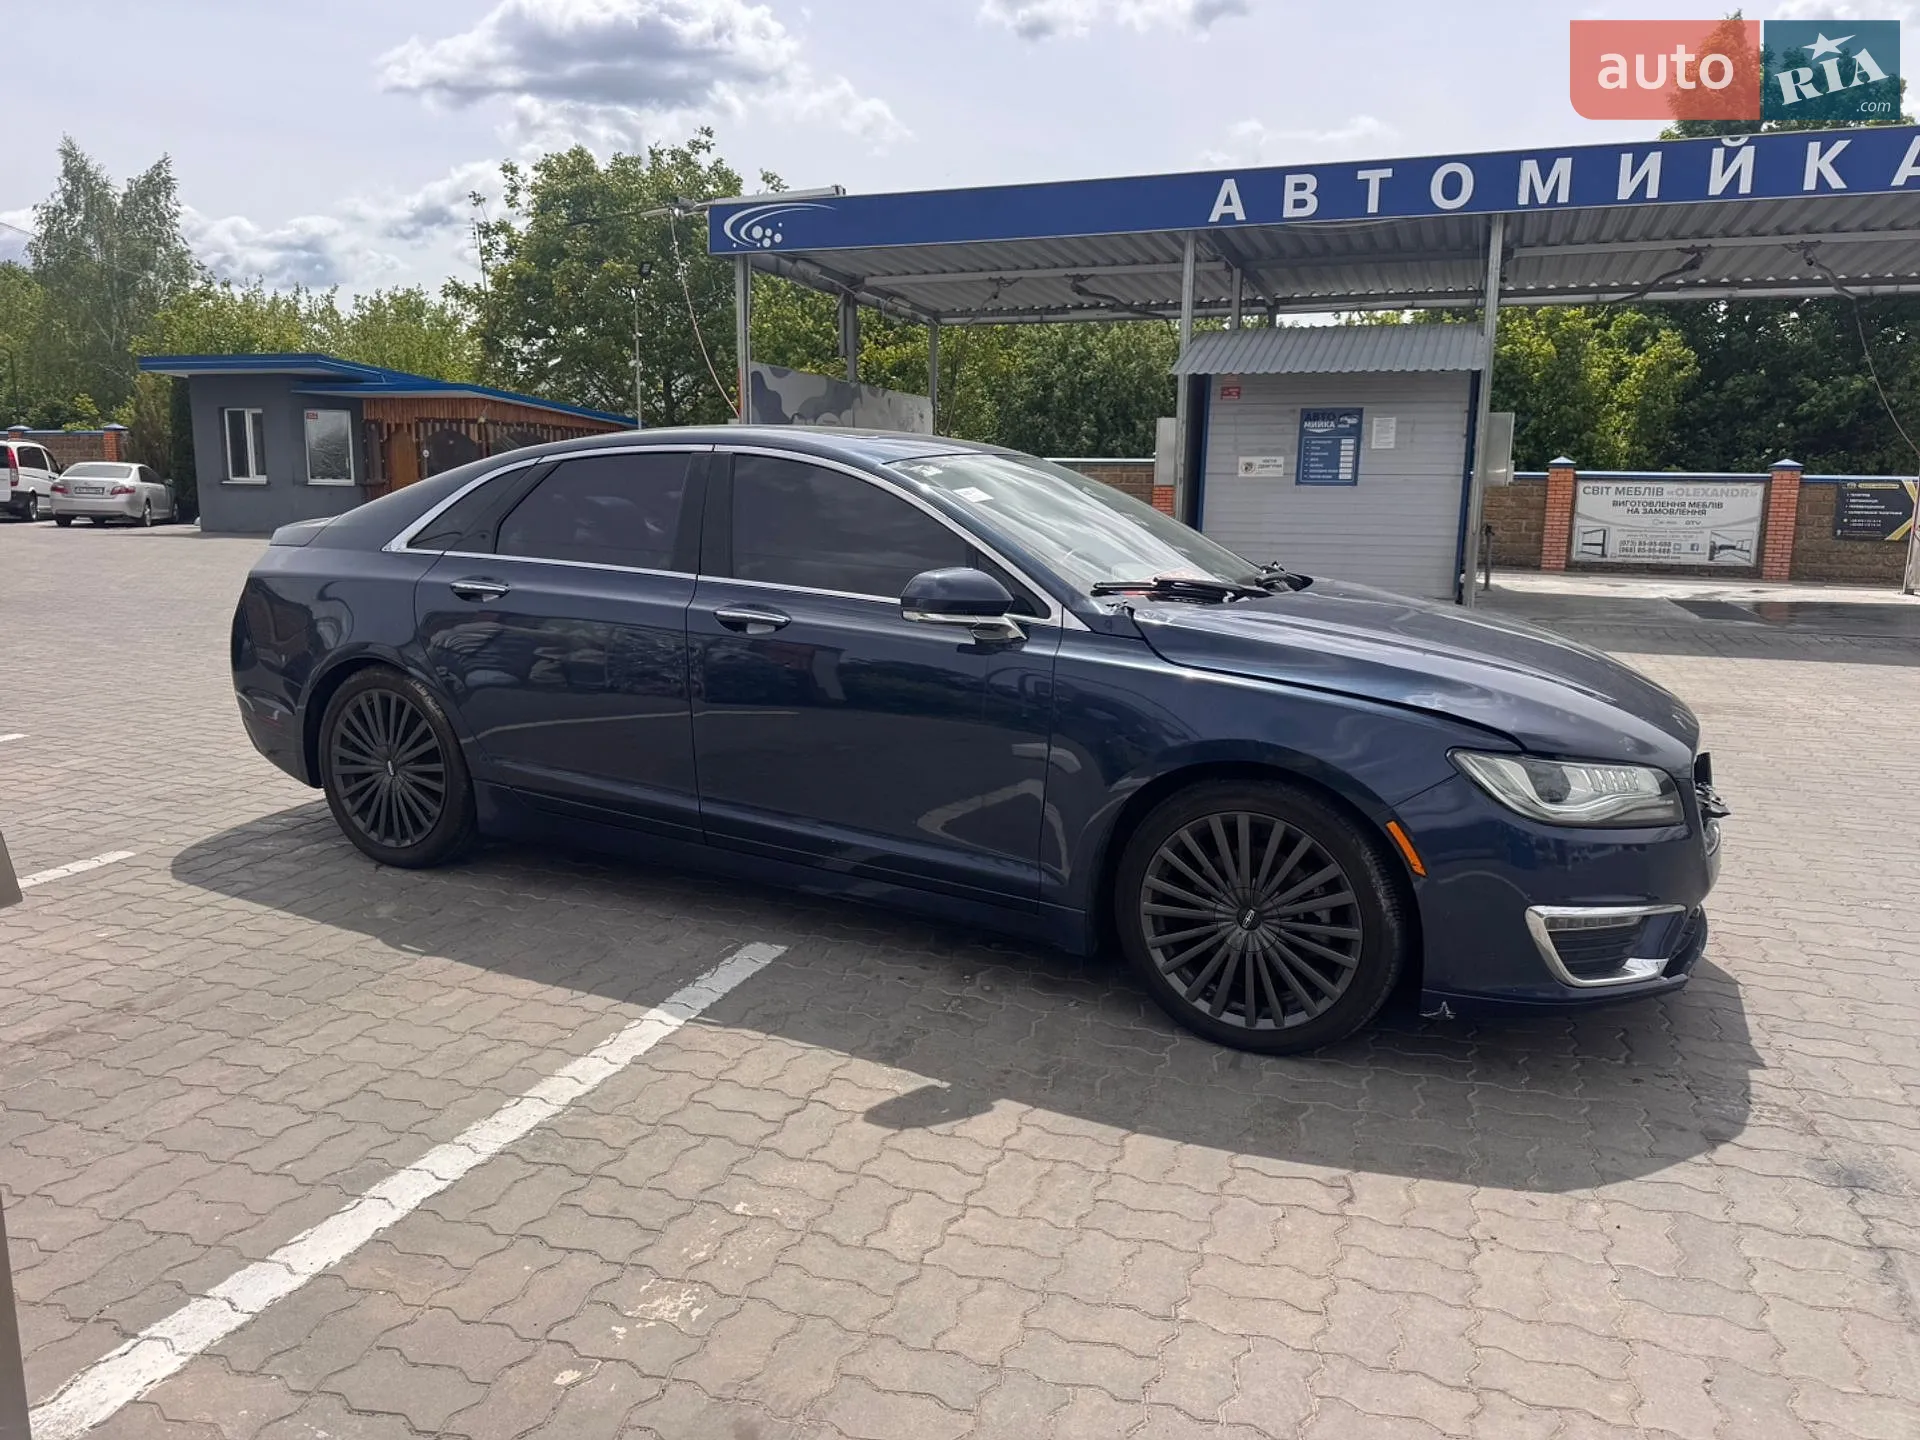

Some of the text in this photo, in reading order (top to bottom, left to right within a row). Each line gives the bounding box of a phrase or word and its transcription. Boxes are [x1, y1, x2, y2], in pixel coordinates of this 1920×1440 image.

[1582, 485, 1664, 497] СВІТ МЕБЛІВ
[1612, 500, 1724, 510] ВИГОТОВЛЕННЯ МЕБЛІВ
[1641, 508, 1707, 516] ЗАМОВЛЕННЯ
